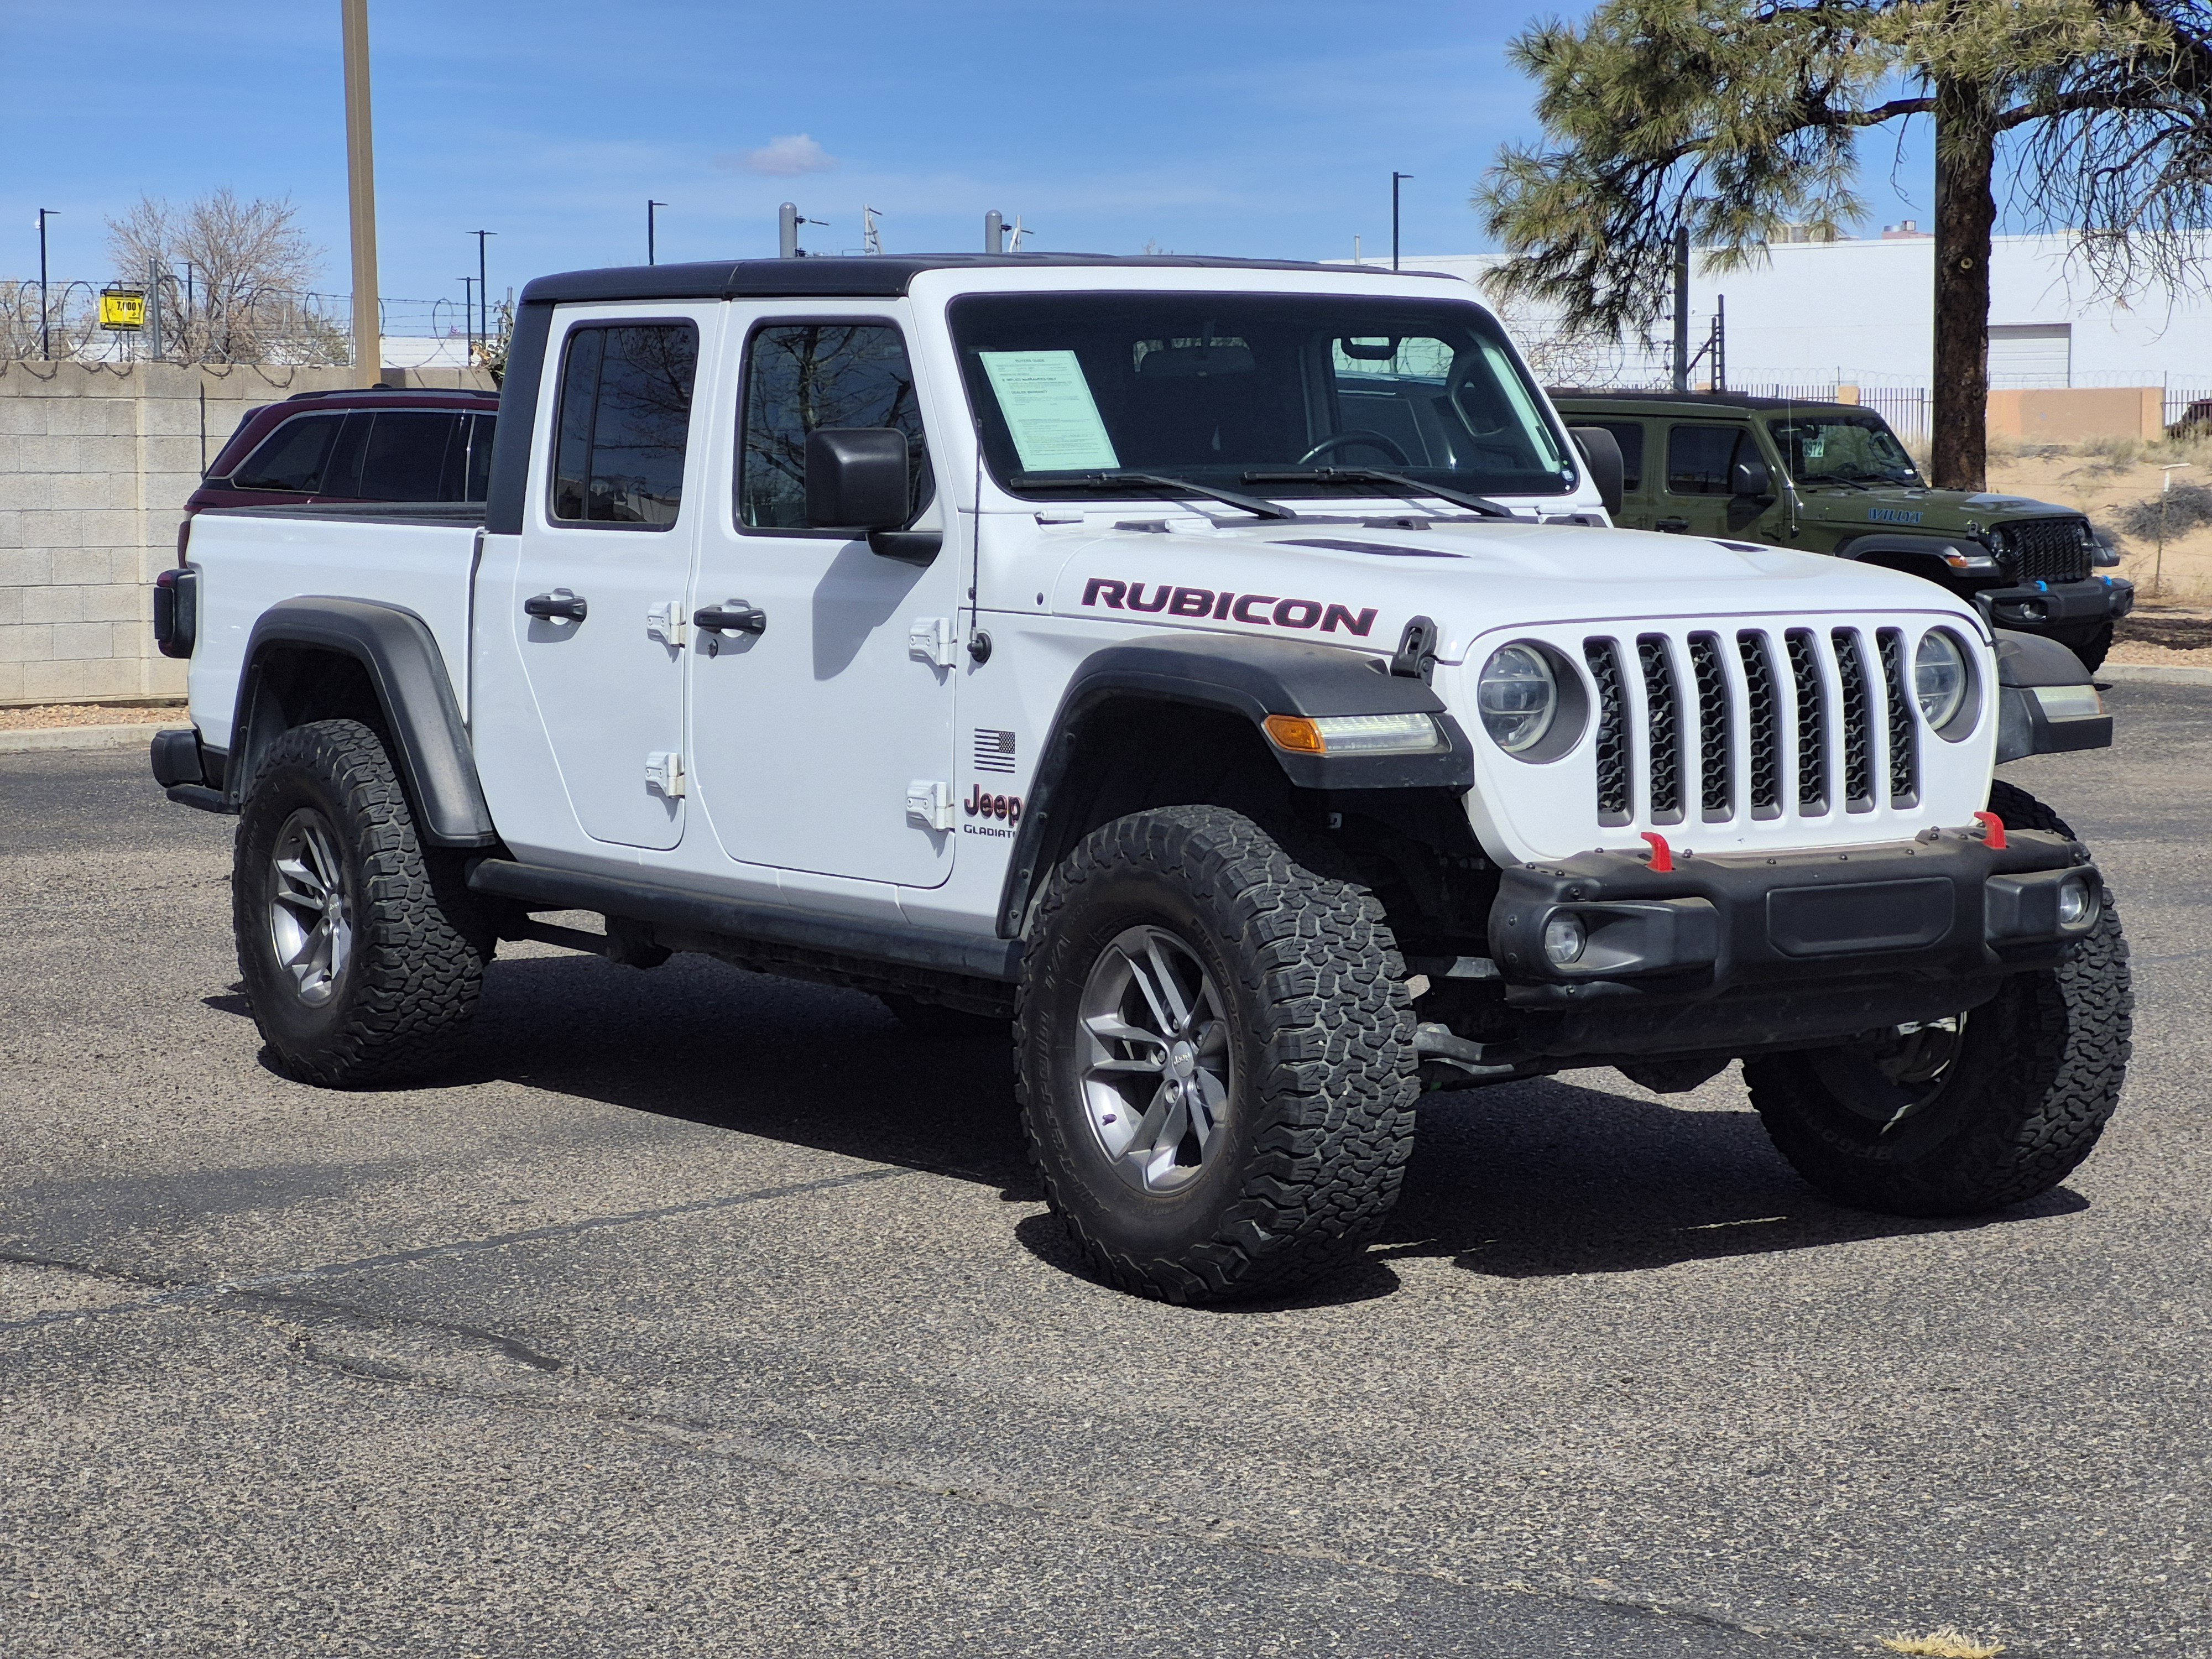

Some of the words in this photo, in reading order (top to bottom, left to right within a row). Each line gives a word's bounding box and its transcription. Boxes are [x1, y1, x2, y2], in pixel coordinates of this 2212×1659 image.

[1804, 441, 1823, 456] 3972
[1868, 507, 1924, 524] WILLYS
[1081, 577, 1379, 637] RUBICON
[964, 784, 1022, 827] Jeep
